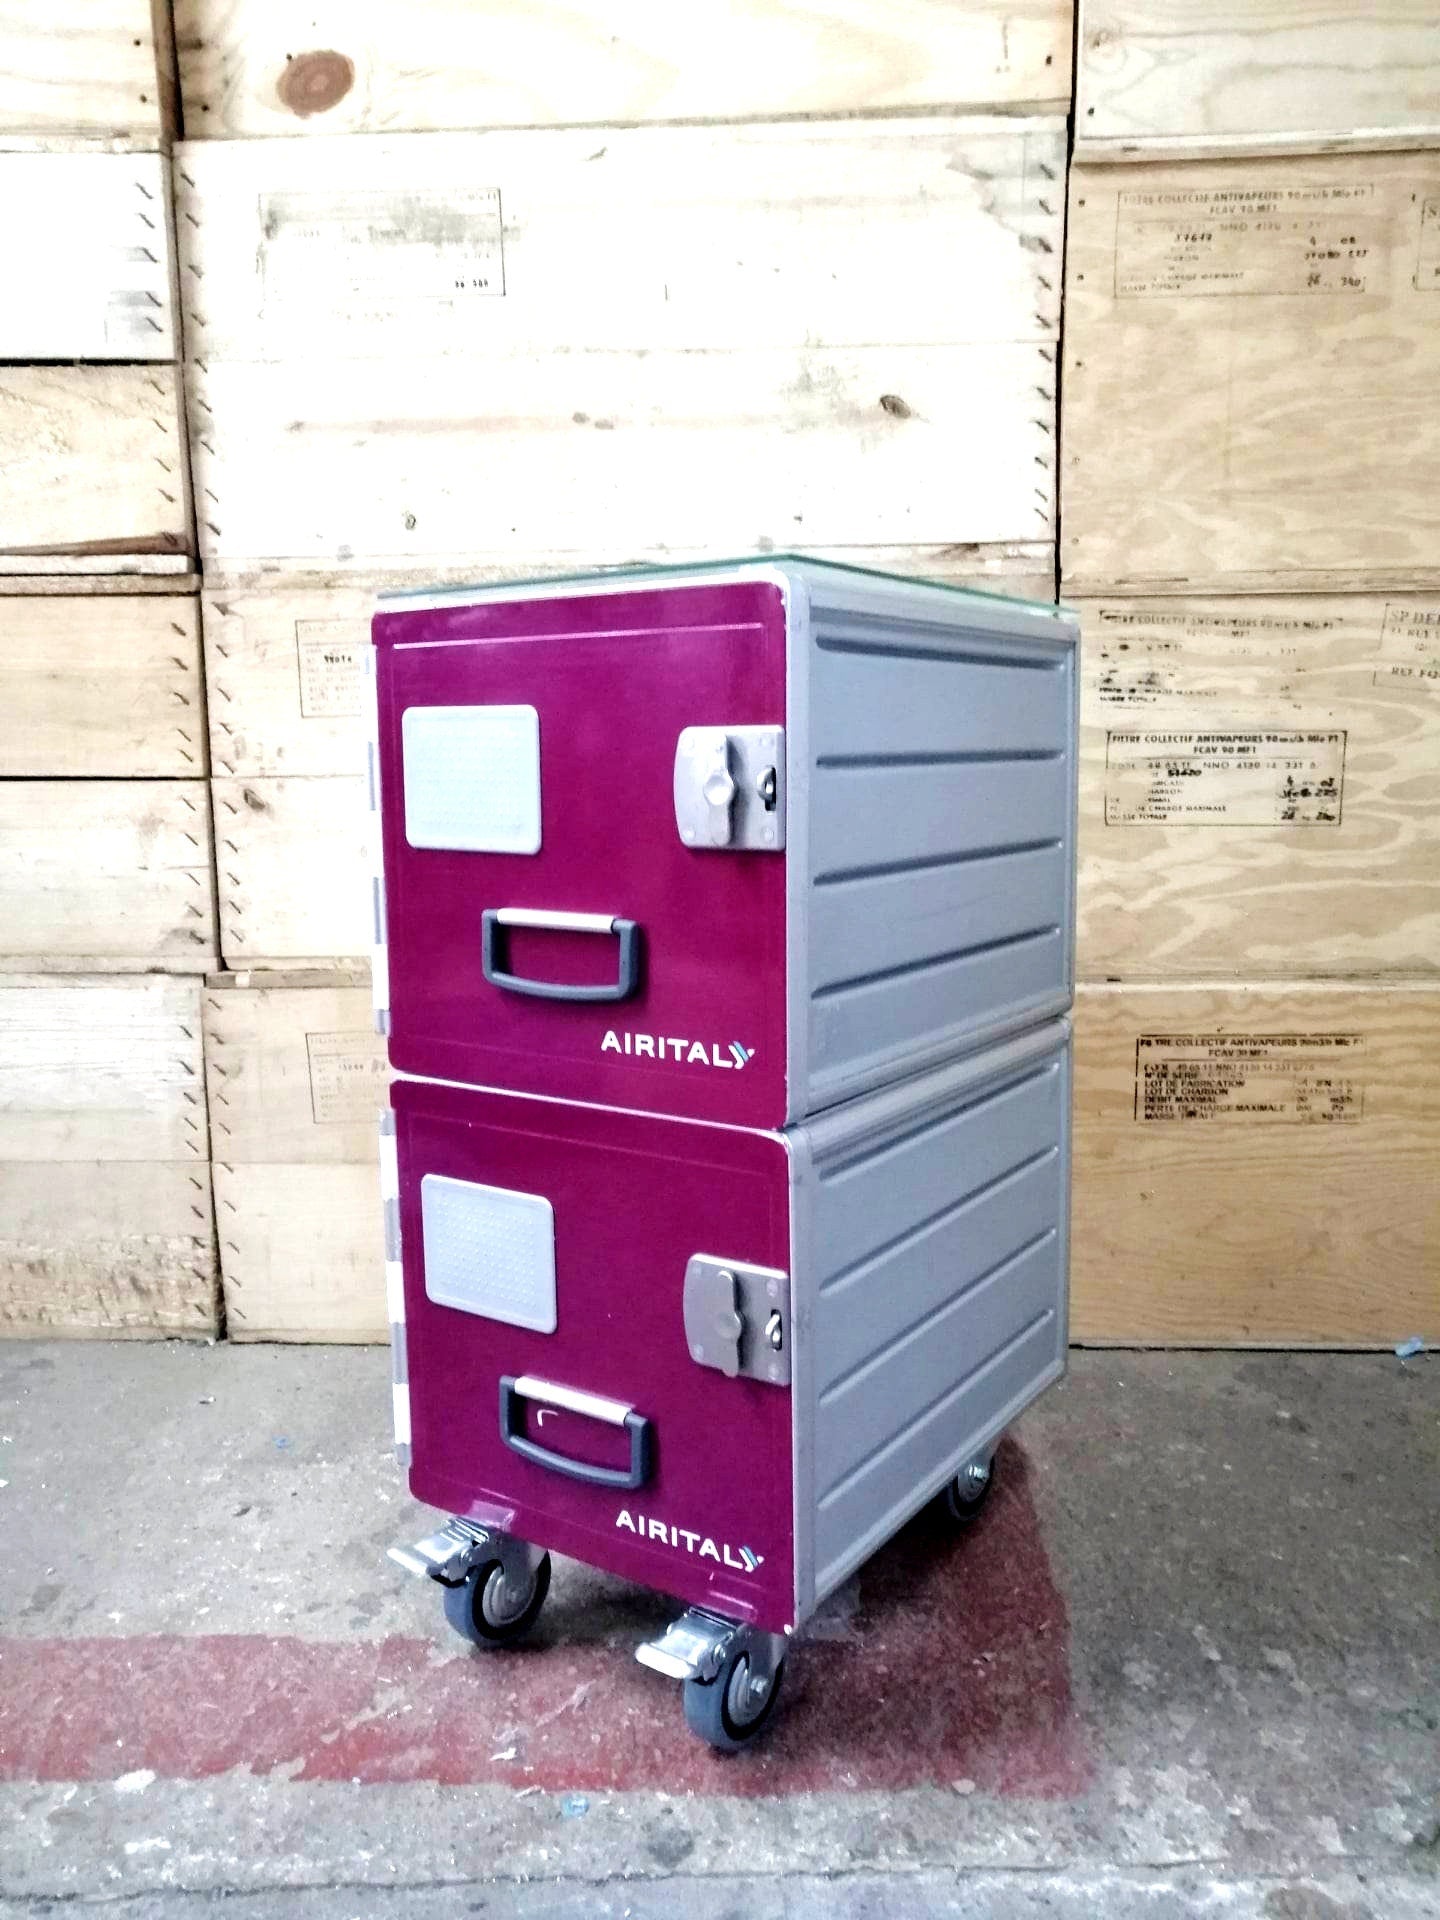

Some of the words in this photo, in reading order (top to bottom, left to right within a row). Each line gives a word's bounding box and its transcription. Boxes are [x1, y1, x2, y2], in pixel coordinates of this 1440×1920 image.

[1144, 735, 1193, 743] COLLECTIF
[1175, 1038, 1227, 1047] COLLECTIF
[1230, 1037, 1298, 1047] ANTIVAPEURS
[1208, 1049, 1234, 1057] FCAV
[1235, 1103, 1287, 1113] MAXIMALE
